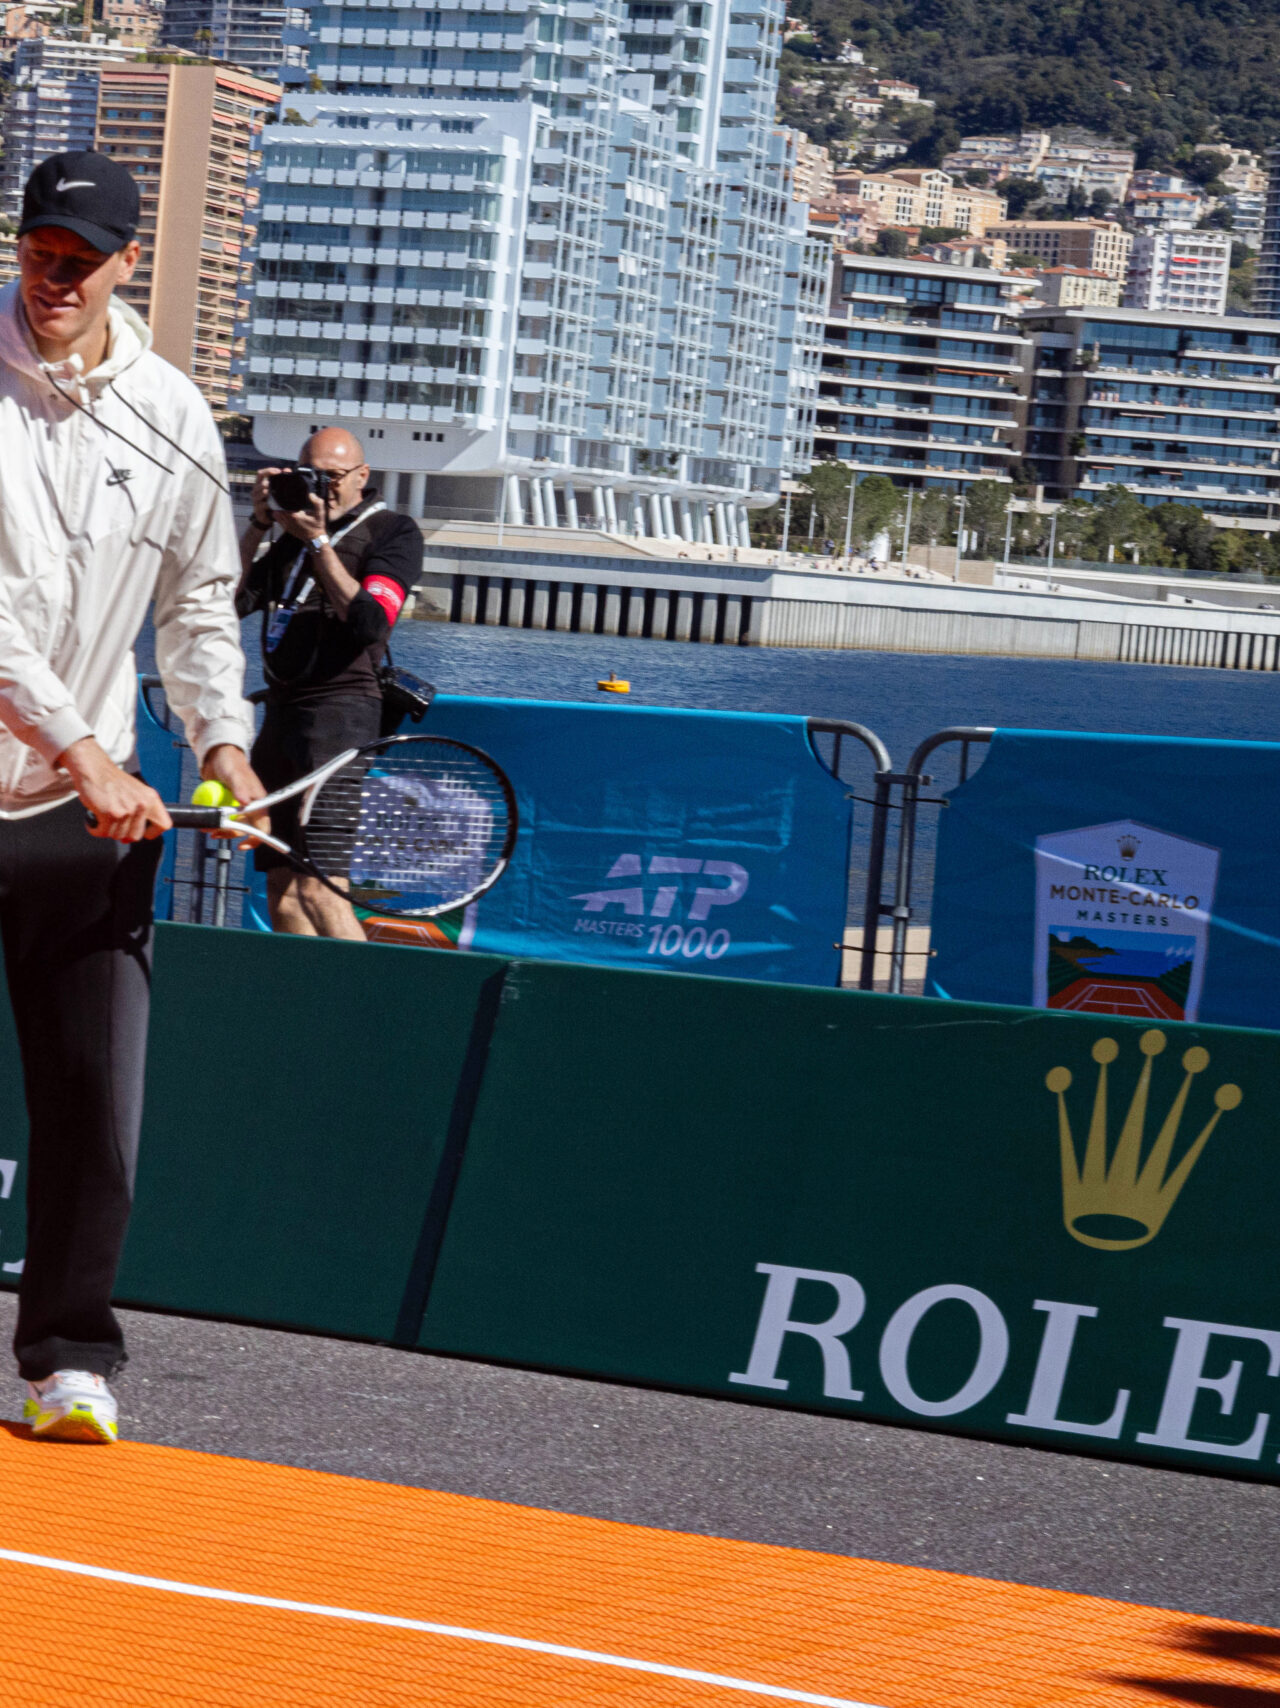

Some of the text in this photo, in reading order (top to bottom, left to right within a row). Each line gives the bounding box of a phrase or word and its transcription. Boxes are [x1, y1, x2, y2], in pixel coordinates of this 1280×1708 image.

[568, 853, 749, 921] ATP
[1083, 864, 1169, 887] ROLEX
[1050, 884, 1200, 910] MONTE-CARLO
[1076, 909, 1170, 927] MASTERS
[574, 918, 731, 960] MASTERS 1000
[727, 1262, 1280, 1464] ROLE
